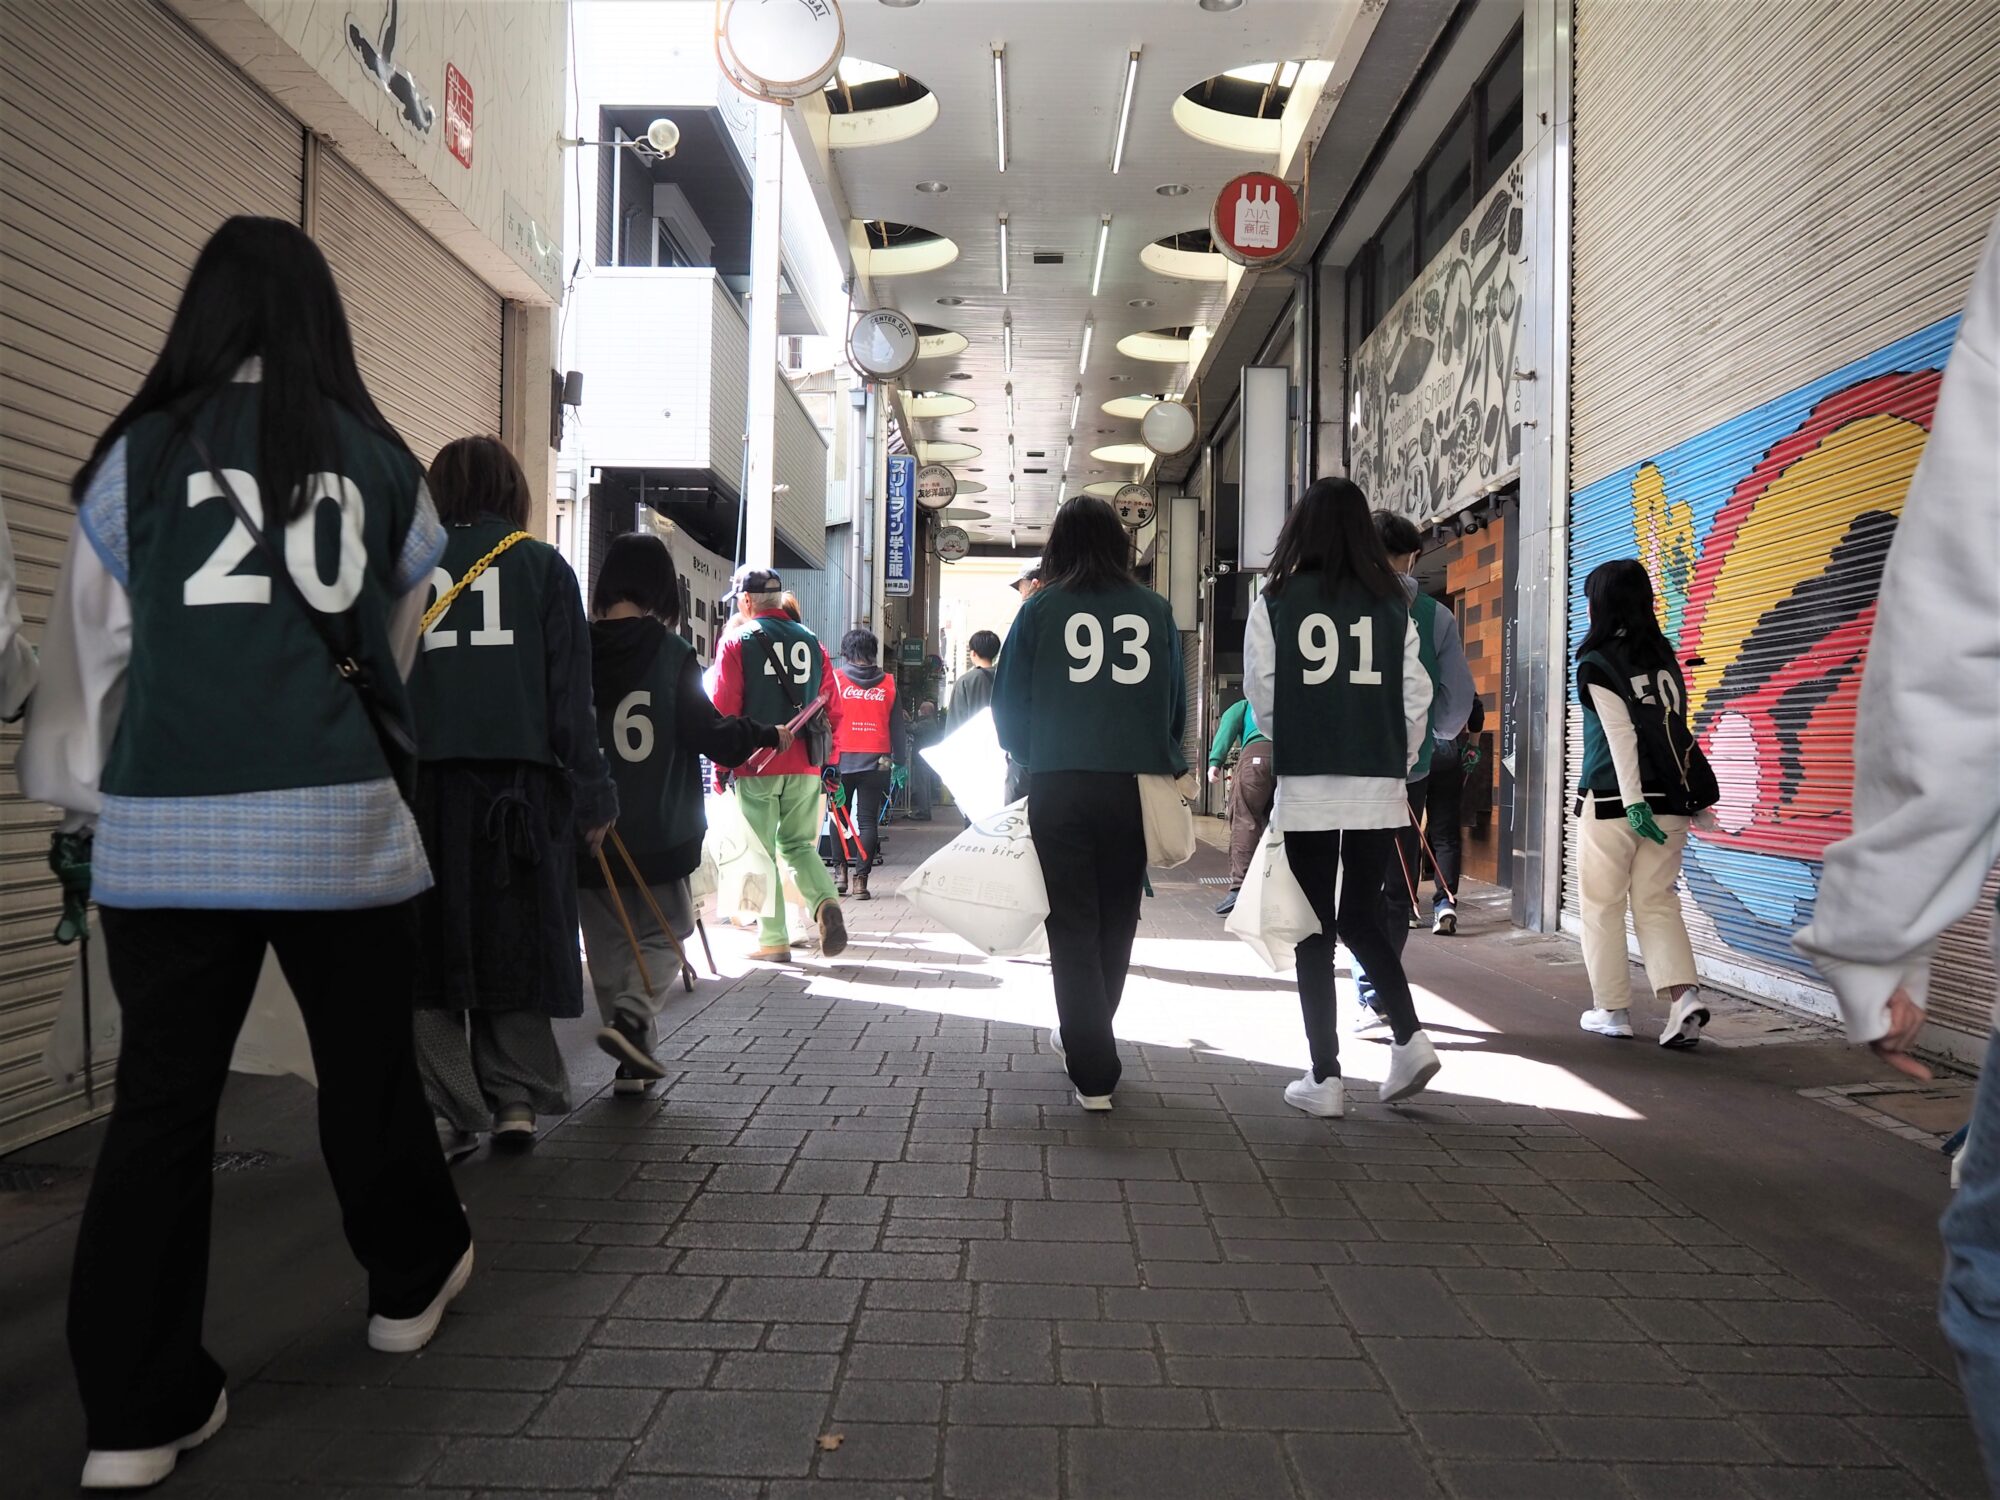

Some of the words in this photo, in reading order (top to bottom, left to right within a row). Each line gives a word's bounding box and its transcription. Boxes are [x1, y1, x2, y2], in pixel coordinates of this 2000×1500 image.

[1244, 223, 1270, 235] 商店
[870, 315, 897, 325] CENTER
[898, 323, 909, 336] GAI
[184, 469, 367, 613] 20
[889, 460, 906, 577] スリーライン学生服
[422, 566, 514, 652] 21
[764, 641, 812, 685] 49
[1064, 612, 1151, 684] 93
[1298, 613, 1382, 685] 91
[599, 690, 655, 763] 6
[951, 843, 986, 854] green
[991, 844, 1026, 860] bird
